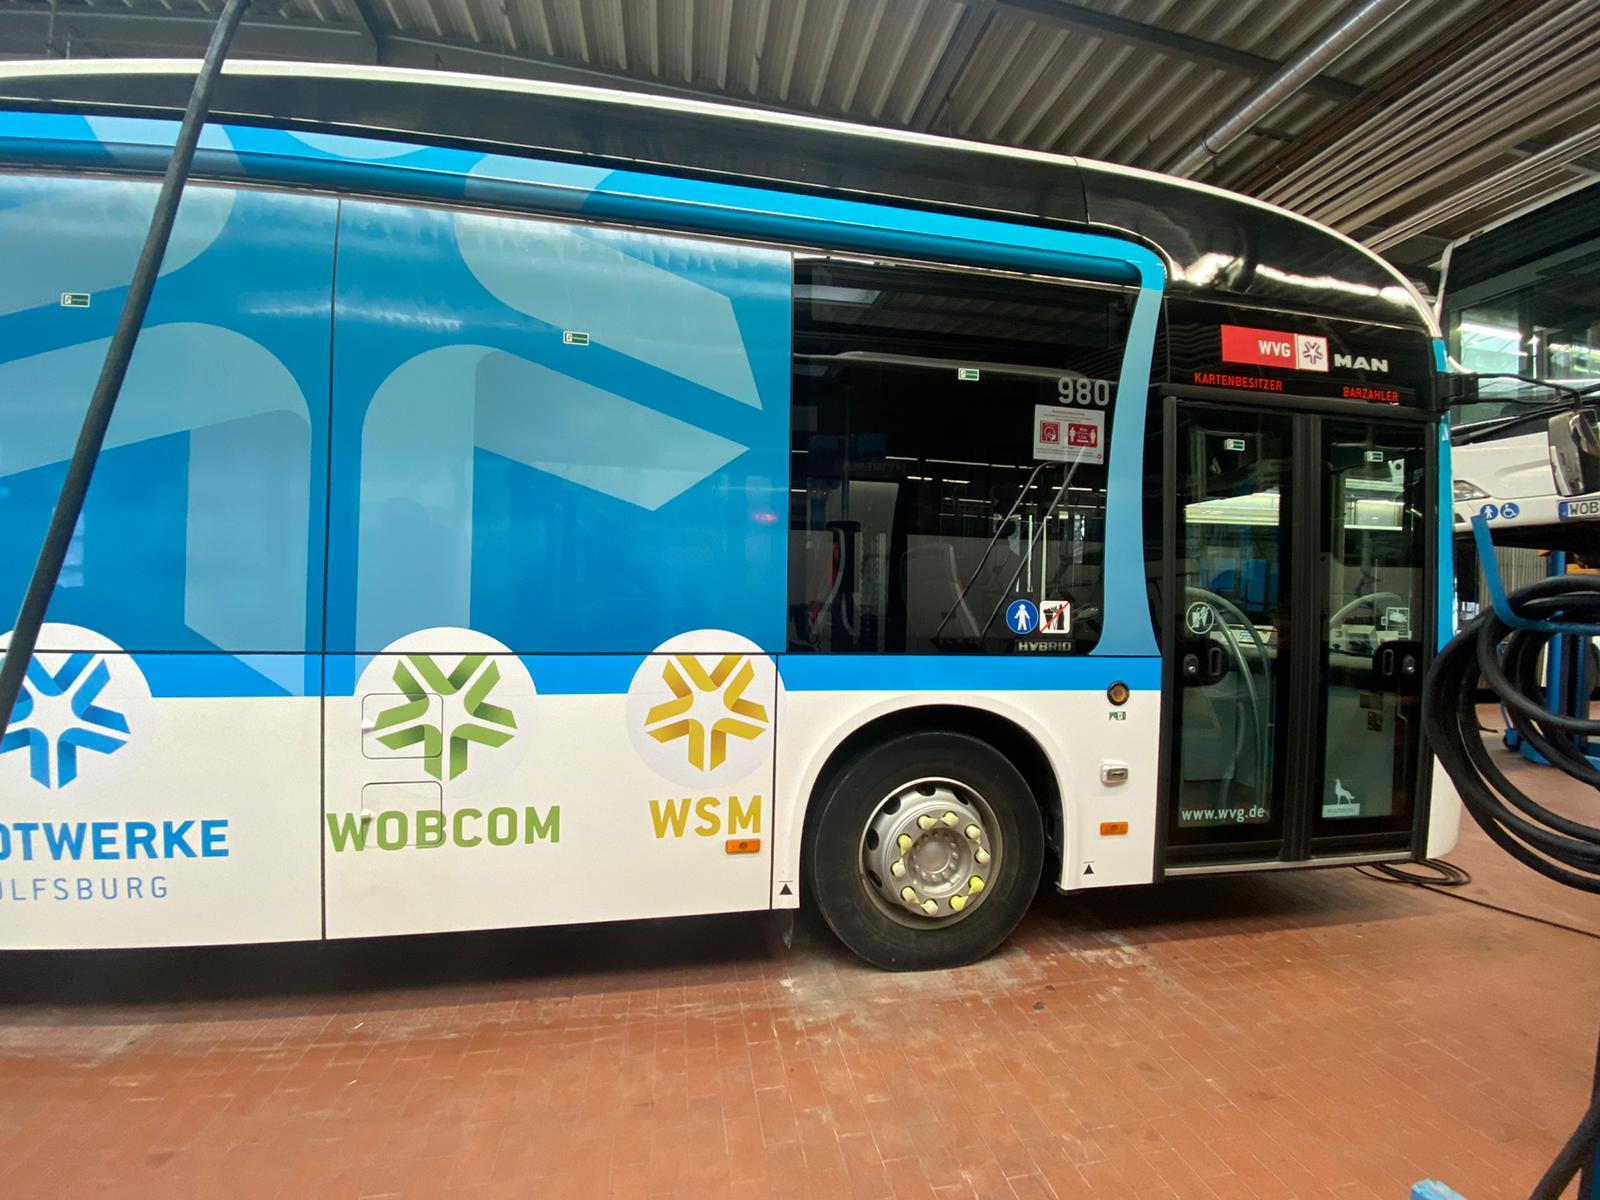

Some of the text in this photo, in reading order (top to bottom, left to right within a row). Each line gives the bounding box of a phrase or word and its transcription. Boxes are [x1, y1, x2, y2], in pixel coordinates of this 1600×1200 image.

[1258, 339, 1291, 358] WVG
[1333, 353, 1389, 373] MAN
[1057, 376, 1110, 406] 980
[1194, 372, 1283, 392] KARTENBESITZER
[1342, 386, 1399, 402] BARZAHLER
[1569, 501, 1599, 515] WOB
[1018, 641, 1072, 652] HYBRID
[648, 795, 762, 839] WSM
[1181, 804, 1265, 823] www.wvg.de
[326, 805, 561, 852] WOBCOM
[0, 876, 168, 901] LFSBURG
